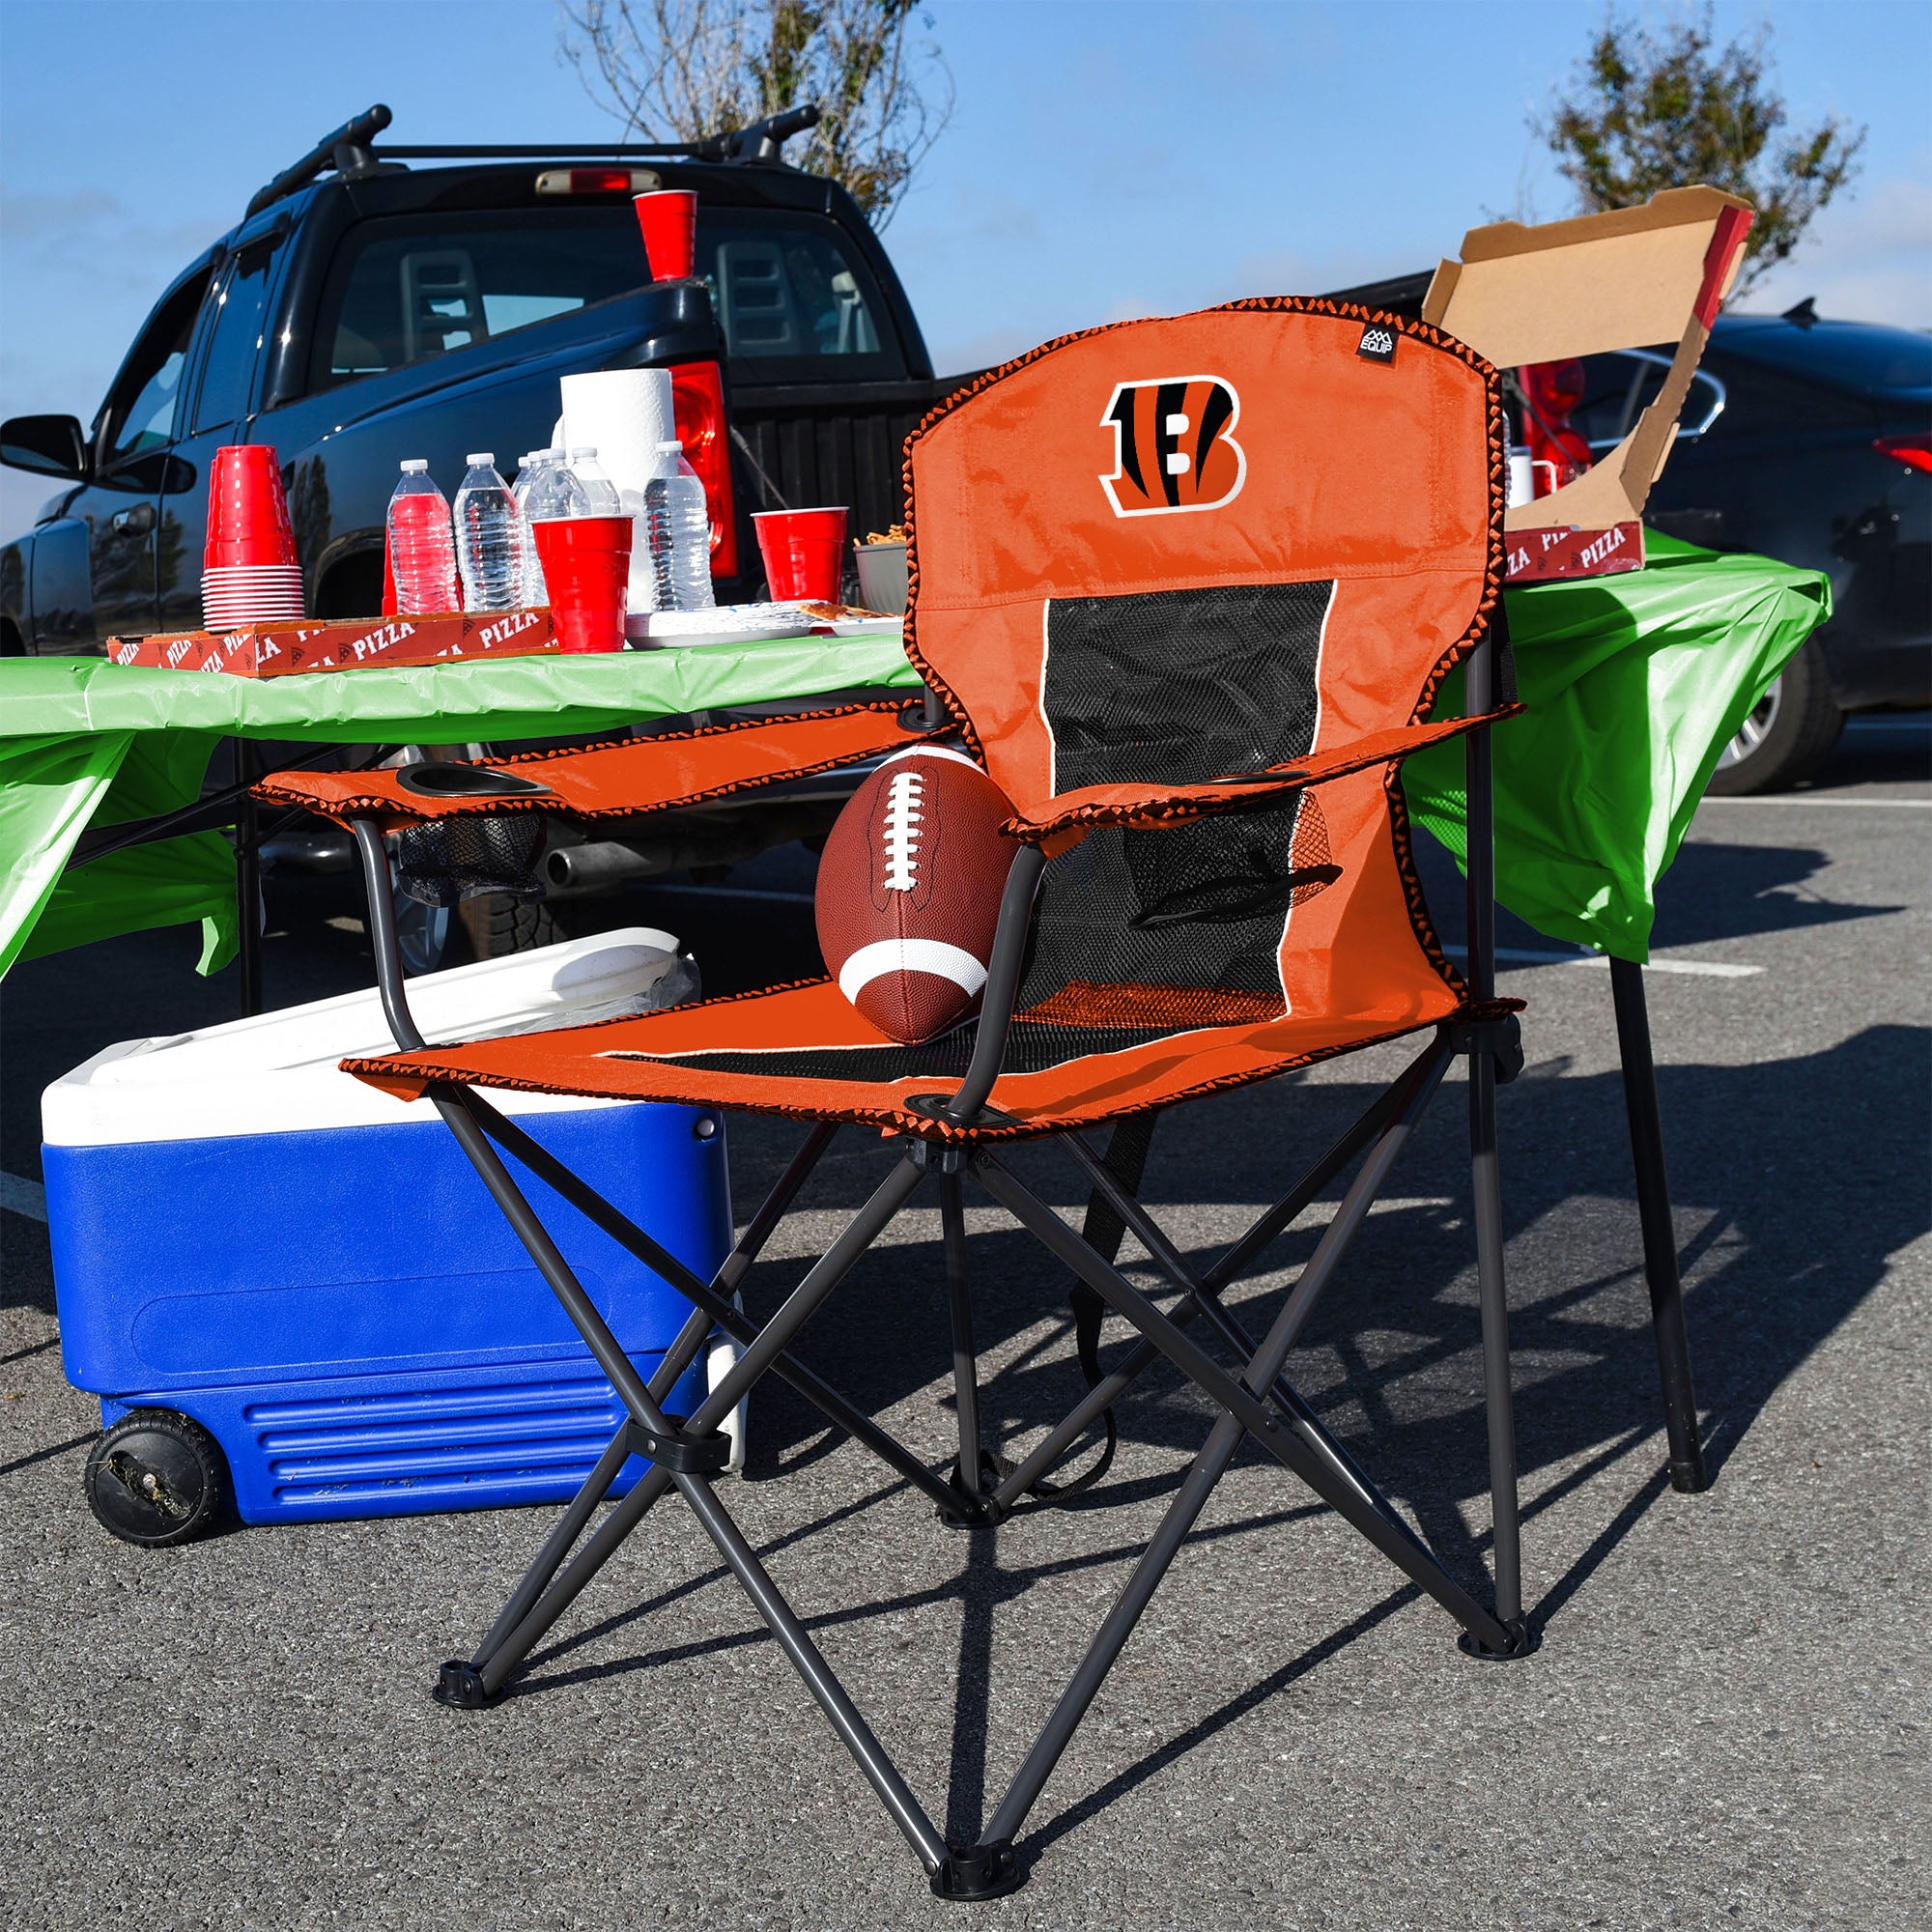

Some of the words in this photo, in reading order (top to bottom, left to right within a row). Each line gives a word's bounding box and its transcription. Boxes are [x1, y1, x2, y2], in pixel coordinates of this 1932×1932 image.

[1360, 338, 1392, 354] EQUIP
[1580, 527, 1627, 568] PIZZA
[352, 621, 416, 661] PIZZA
[478, 611, 540, 649] PIZZA
[116, 643, 140, 666] PIZZA
[166, 639, 192, 670] PIZZA
